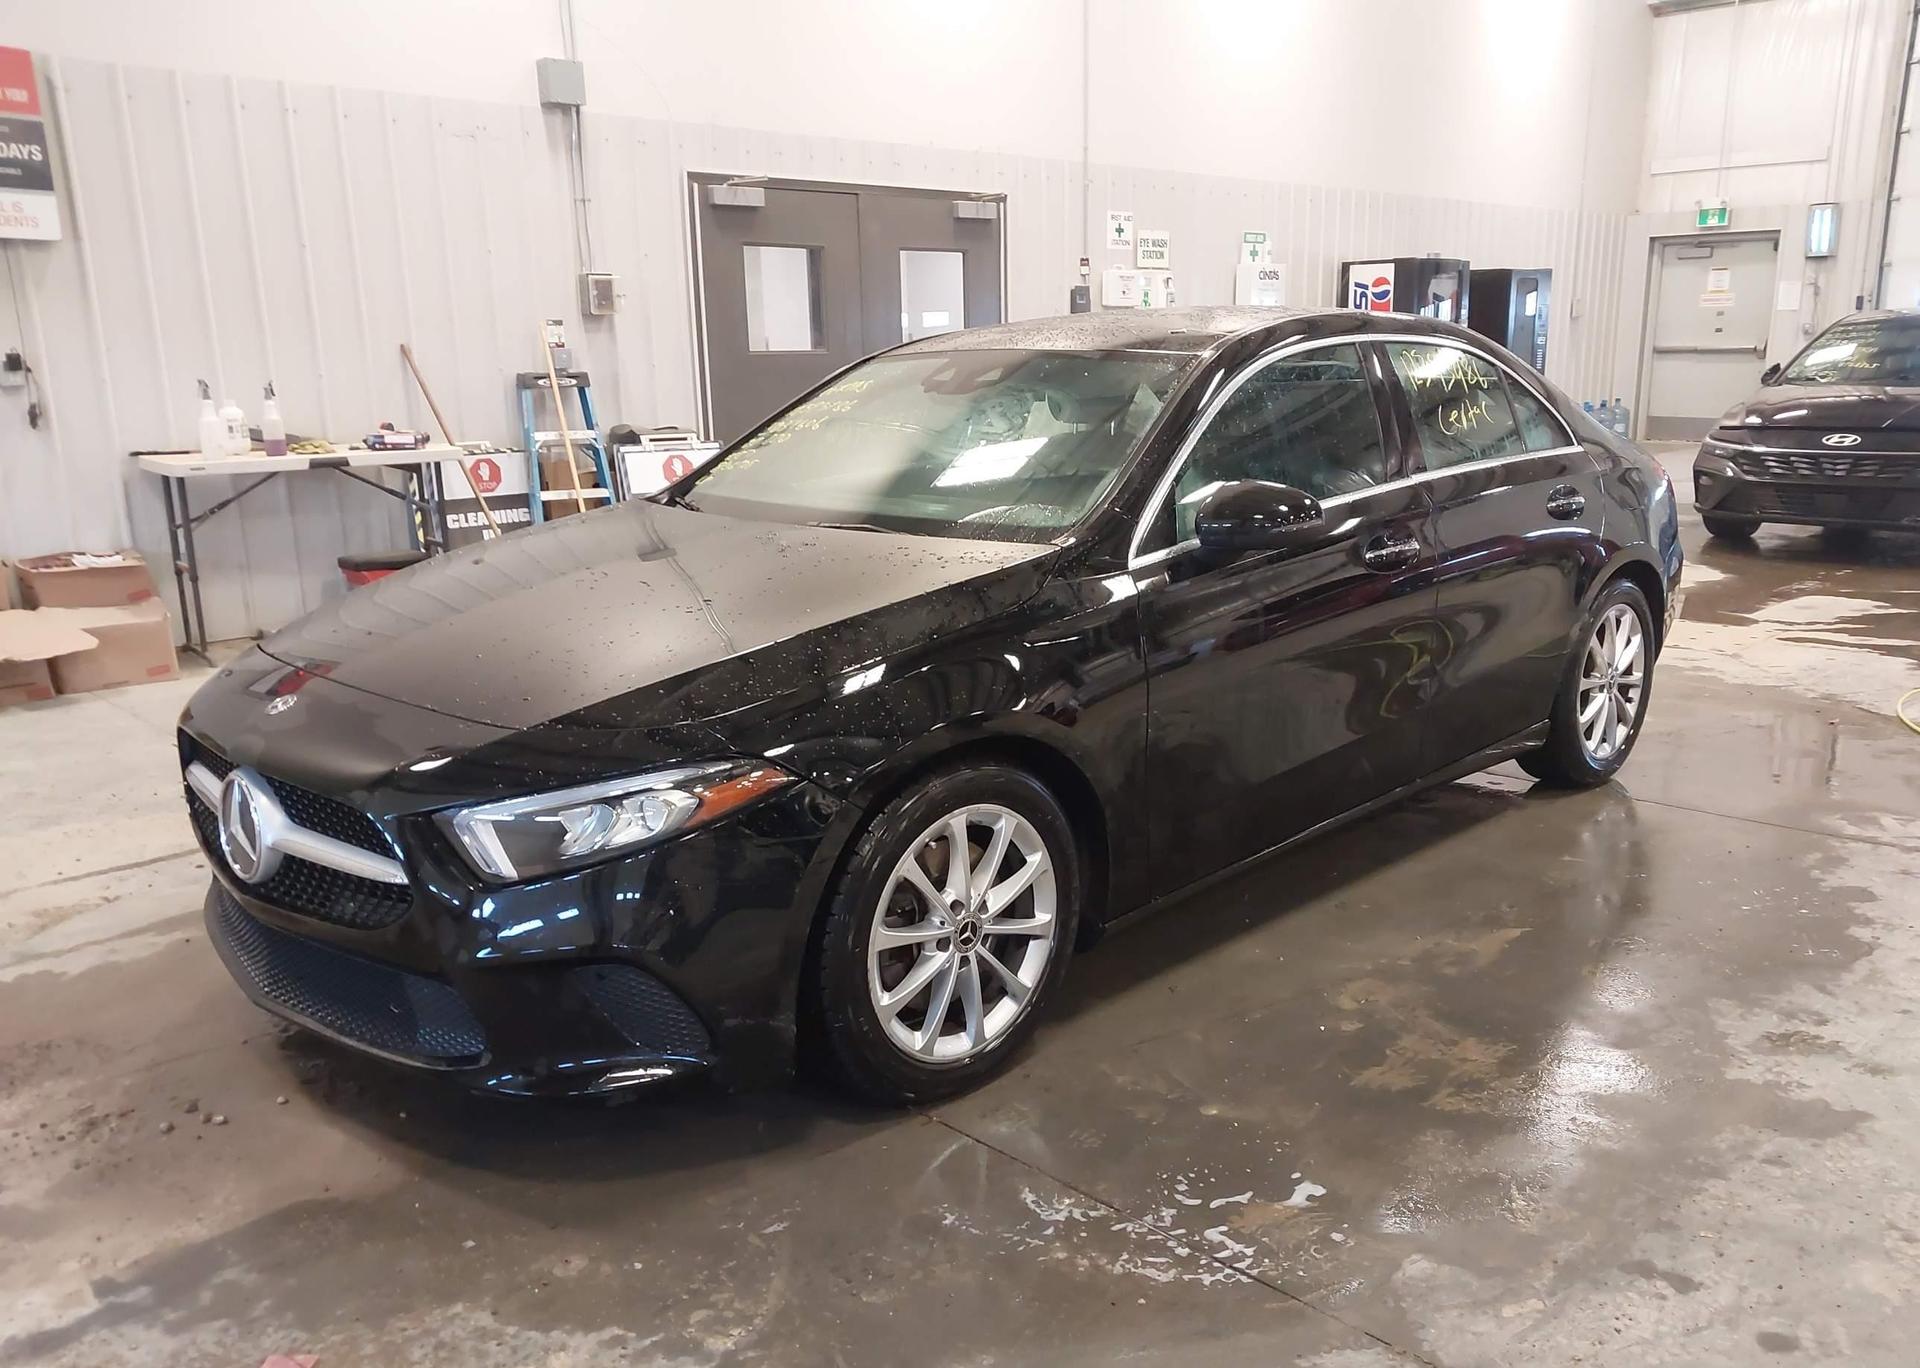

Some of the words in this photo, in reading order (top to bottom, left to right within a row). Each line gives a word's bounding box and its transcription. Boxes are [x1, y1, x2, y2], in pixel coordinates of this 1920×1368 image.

[0, 142, 43, 161] DAYS
[1140, 238, 1150, 248] EYE
[1151, 239, 1168, 248] WASH
[1142, 250, 1165, 259] STATION
[479, 482, 498, 490] STOP
[446, 508, 530, 529] CLEANING
